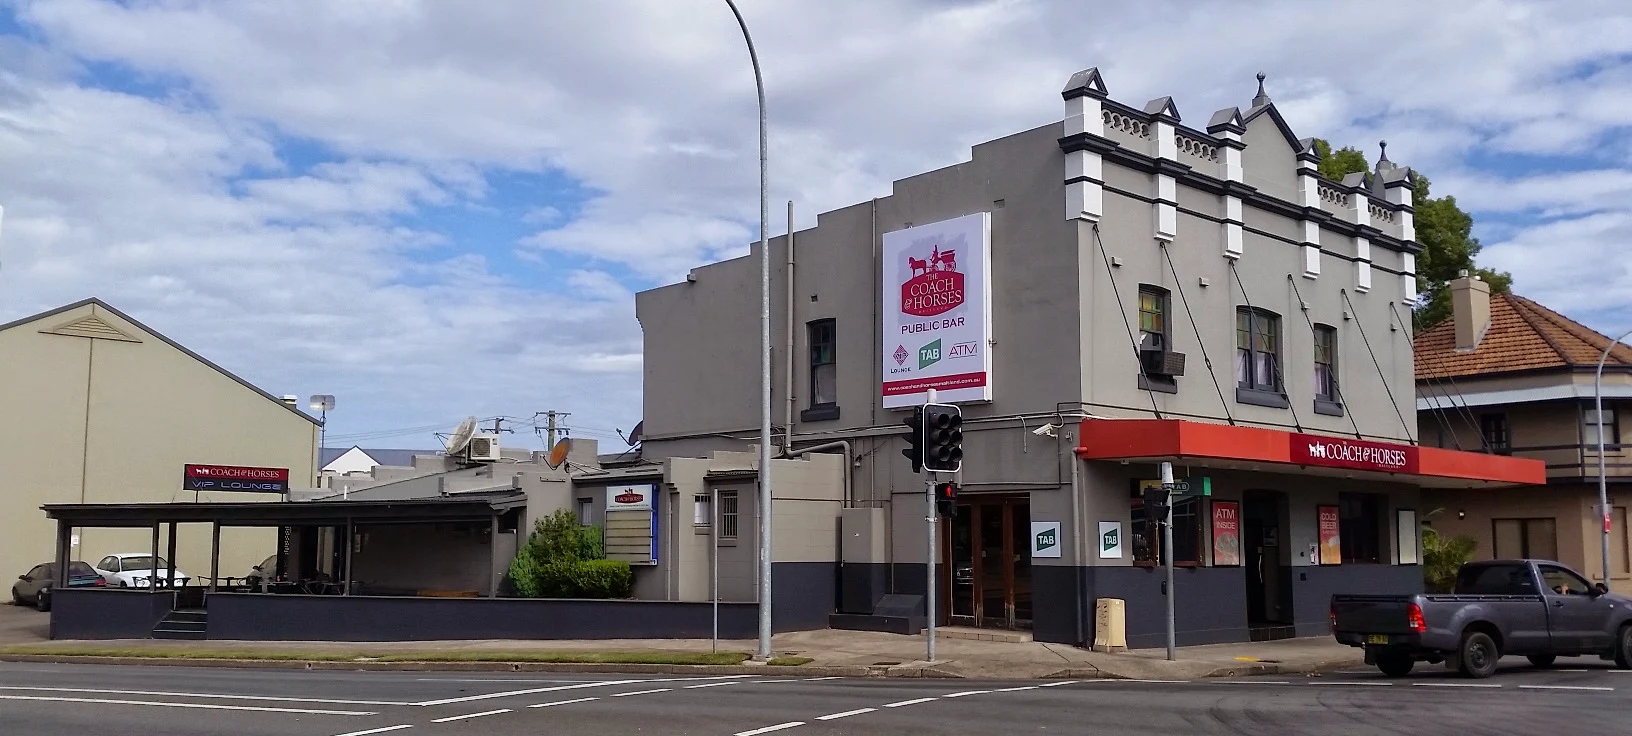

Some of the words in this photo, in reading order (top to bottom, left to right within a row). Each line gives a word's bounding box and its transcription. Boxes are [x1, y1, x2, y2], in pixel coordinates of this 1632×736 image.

[926, 273, 938, 281] THE
[910, 278, 955, 297] COACH
[904, 298, 912, 310] &
[914, 290, 962, 310] HORSES
[901, 321, 940, 334] PUBLIC
[942, 317, 965, 328] BAR
[920, 348, 940, 361] TAB
[948, 343, 978, 357] ATM
[1326, 443, 1362, 462] COACH
[1363, 447, 1371, 461] &
[1371, 448, 1406, 466] HORSES
[210, 468, 240, 477] COACH
[247, 470, 280, 478] HORSES
[221, 481, 281, 490] LOUNGE
[1216, 508, 1235, 520] ATM
[1321, 512, 1337, 521] COLD
[1216, 521, 1235, 530] INSIDE
[1038, 535, 1054, 545] TAB
[1105, 535, 1117, 545] TAB
